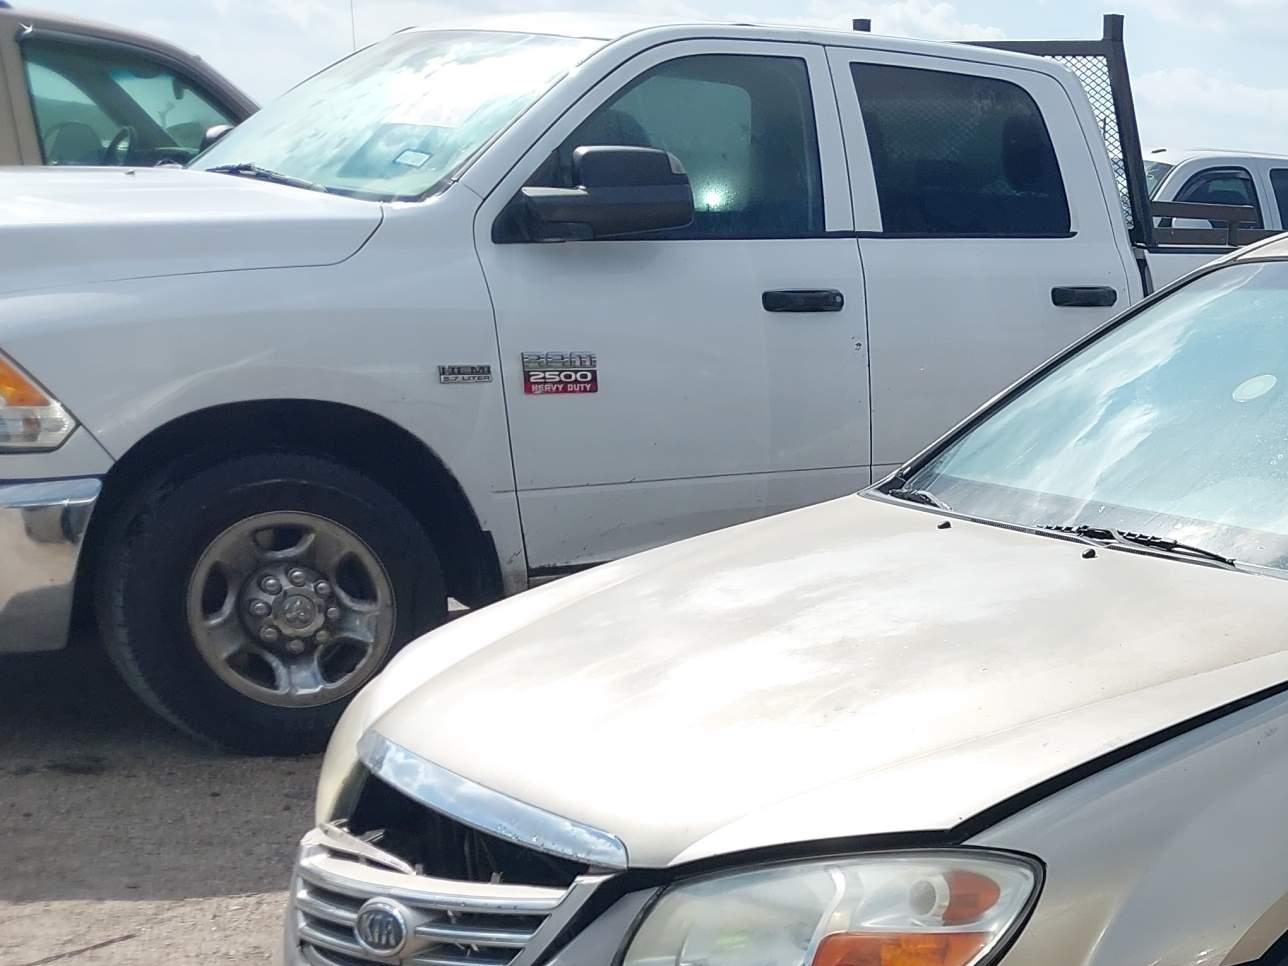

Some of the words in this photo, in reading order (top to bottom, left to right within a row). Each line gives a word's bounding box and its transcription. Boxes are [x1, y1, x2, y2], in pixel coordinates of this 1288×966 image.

[529, 371, 592, 383] 2500
[531, 383, 564, 393] HEAVY
[567, 383, 592, 392] DUTY
